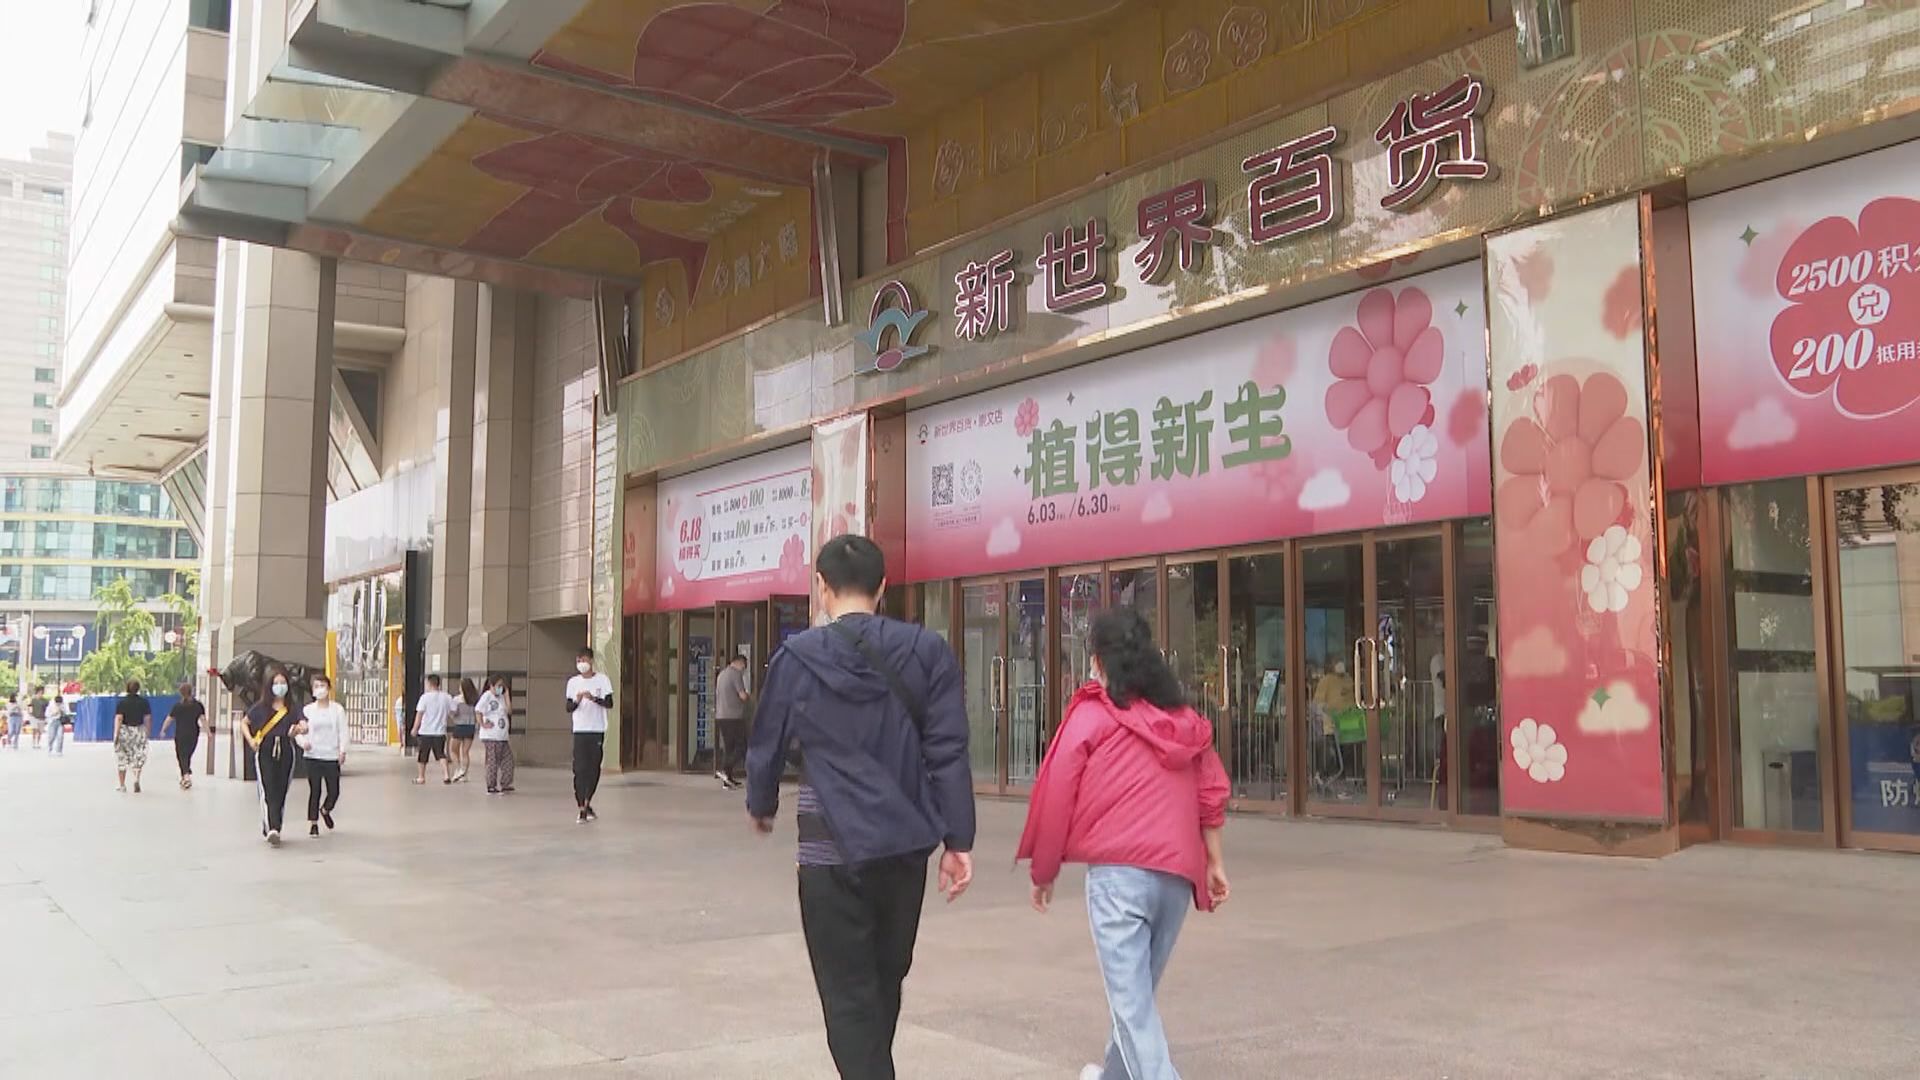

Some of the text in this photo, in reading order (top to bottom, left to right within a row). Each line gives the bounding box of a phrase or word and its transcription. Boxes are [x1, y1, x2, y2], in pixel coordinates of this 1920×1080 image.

[954, 73, 1491, 341] 新世界百货
[1788, 243, 1920, 296] 2500 积
[1856, 290, 1884, 320] 兑
[1788, 328, 1920, 379] 200 抵用
[1023, 379, 1293, 500] 植得新生
[680, 516, 701, 543] 6.18
[1027, 502, 1056, 525] 6.03
[1880, 779, 1920, 807] 防
